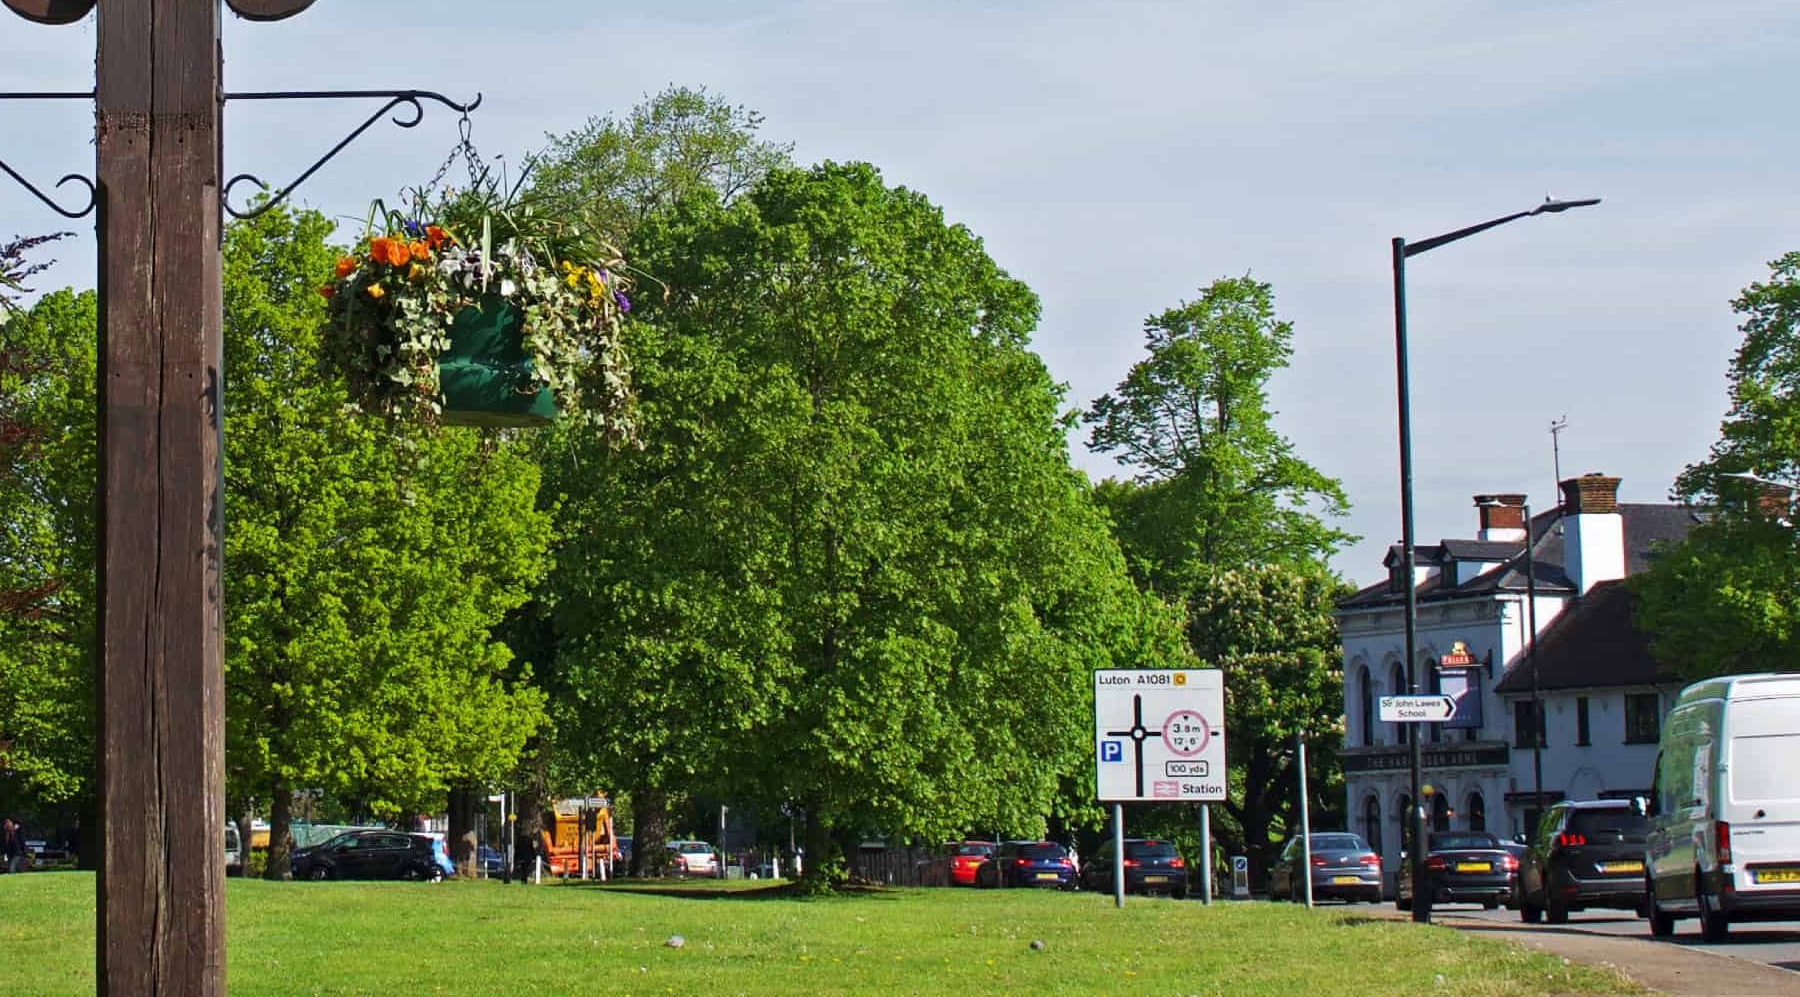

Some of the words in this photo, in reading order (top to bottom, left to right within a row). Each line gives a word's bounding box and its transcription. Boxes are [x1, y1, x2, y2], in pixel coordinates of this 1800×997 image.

[1098, 674, 1131, 685] Luton
[1137, 674, 1171, 685] A1081
[1395, 698, 1414, 708] John
[1398, 709, 1426, 717] School
[1170, 764, 1186, 773] 100
[1188, 764, 1204, 775] yds
[1182, 783, 1223, 795] Station
